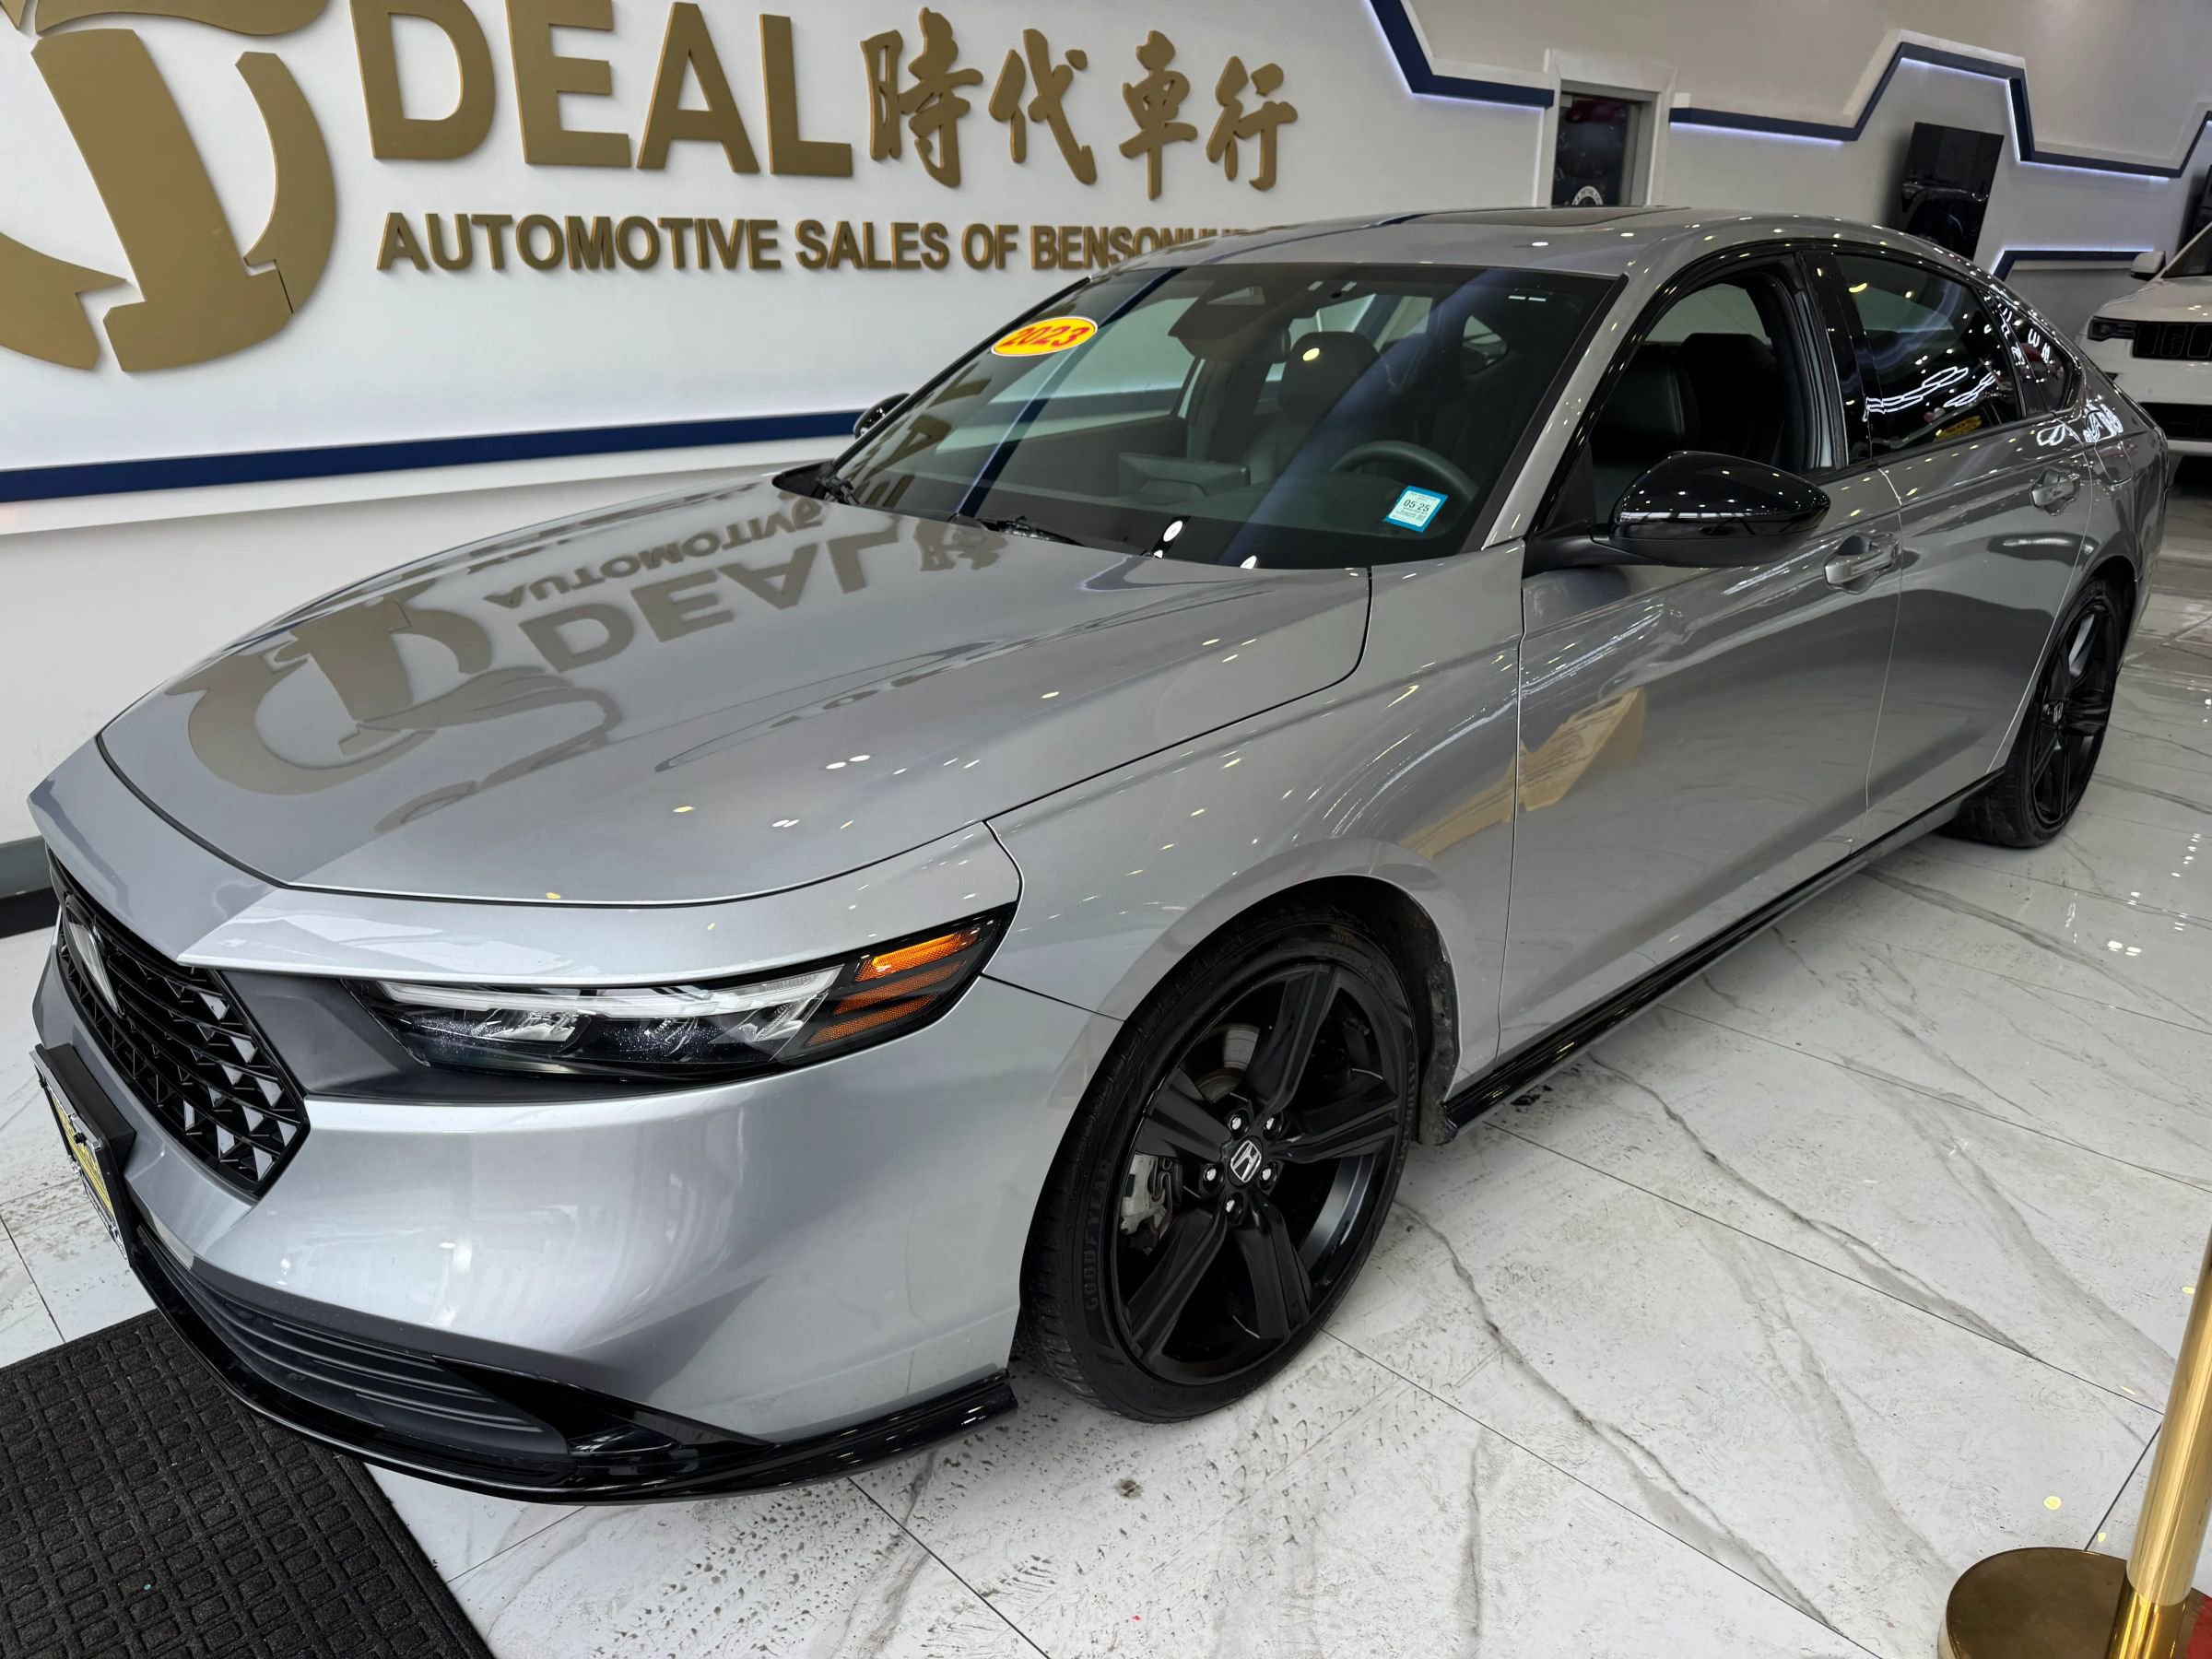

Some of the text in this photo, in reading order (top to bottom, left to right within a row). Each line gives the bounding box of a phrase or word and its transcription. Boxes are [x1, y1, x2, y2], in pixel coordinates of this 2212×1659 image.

[350, 0, 853, 177] DEAL
[860, 7, 1298, 201] 時代車行
[377, 212, 1252, 270] AUTOMOTIVE SALES OF BENSON
[998, 325, 1090, 347] 2023
[1403, 499, 1430, 512] 05 25
